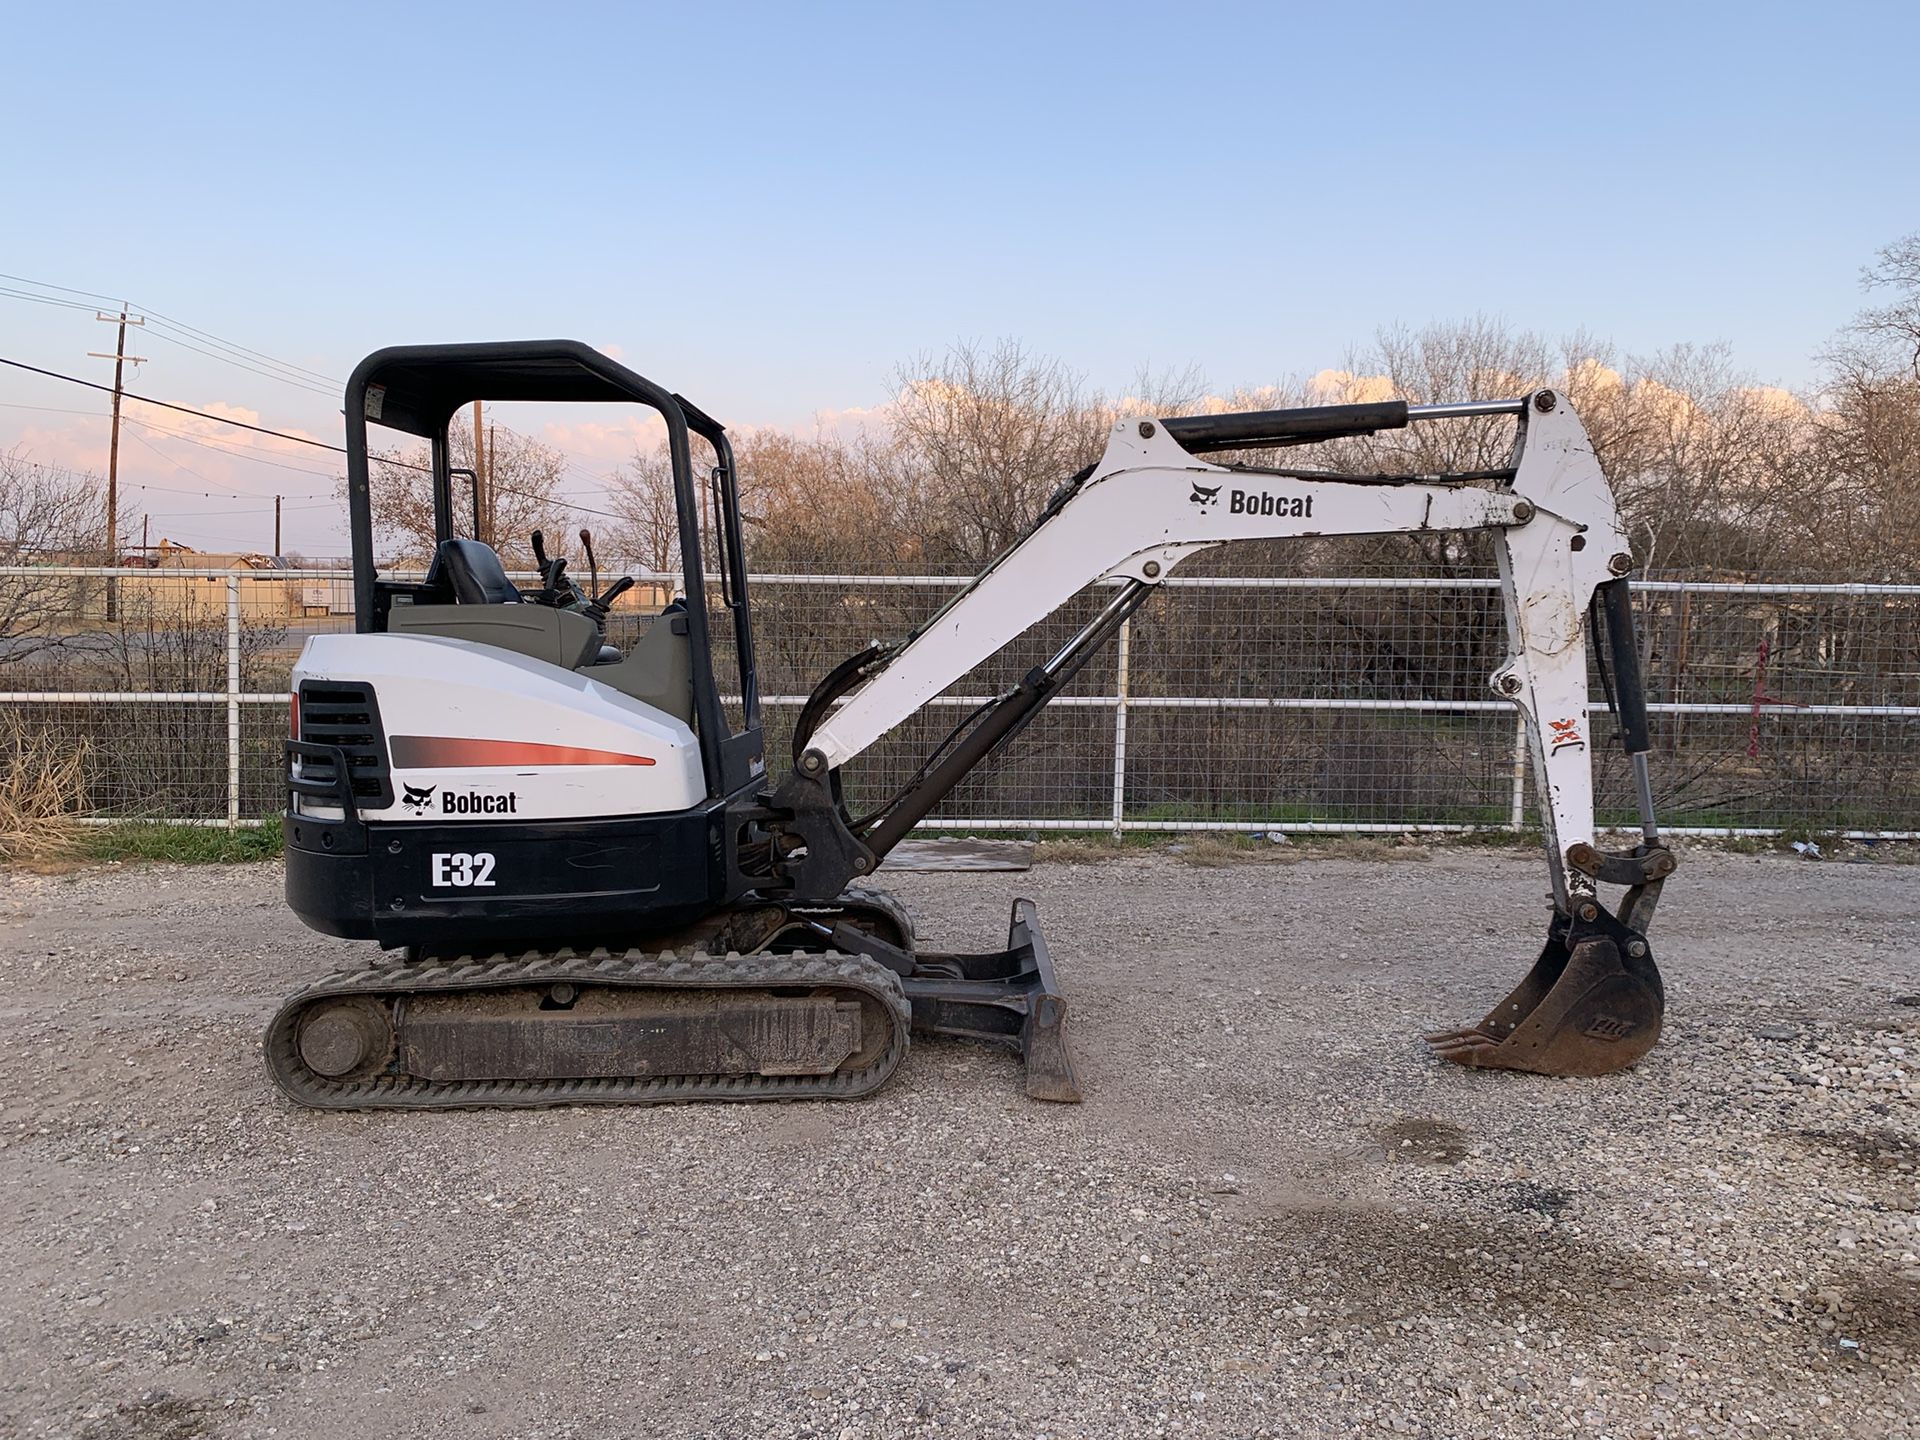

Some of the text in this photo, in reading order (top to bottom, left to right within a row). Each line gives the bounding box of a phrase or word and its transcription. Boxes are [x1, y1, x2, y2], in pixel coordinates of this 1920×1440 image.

[1230, 489, 1313, 518] Bobcat
[442, 791, 517, 814] Bobcat
[431, 852, 496, 887] E32
